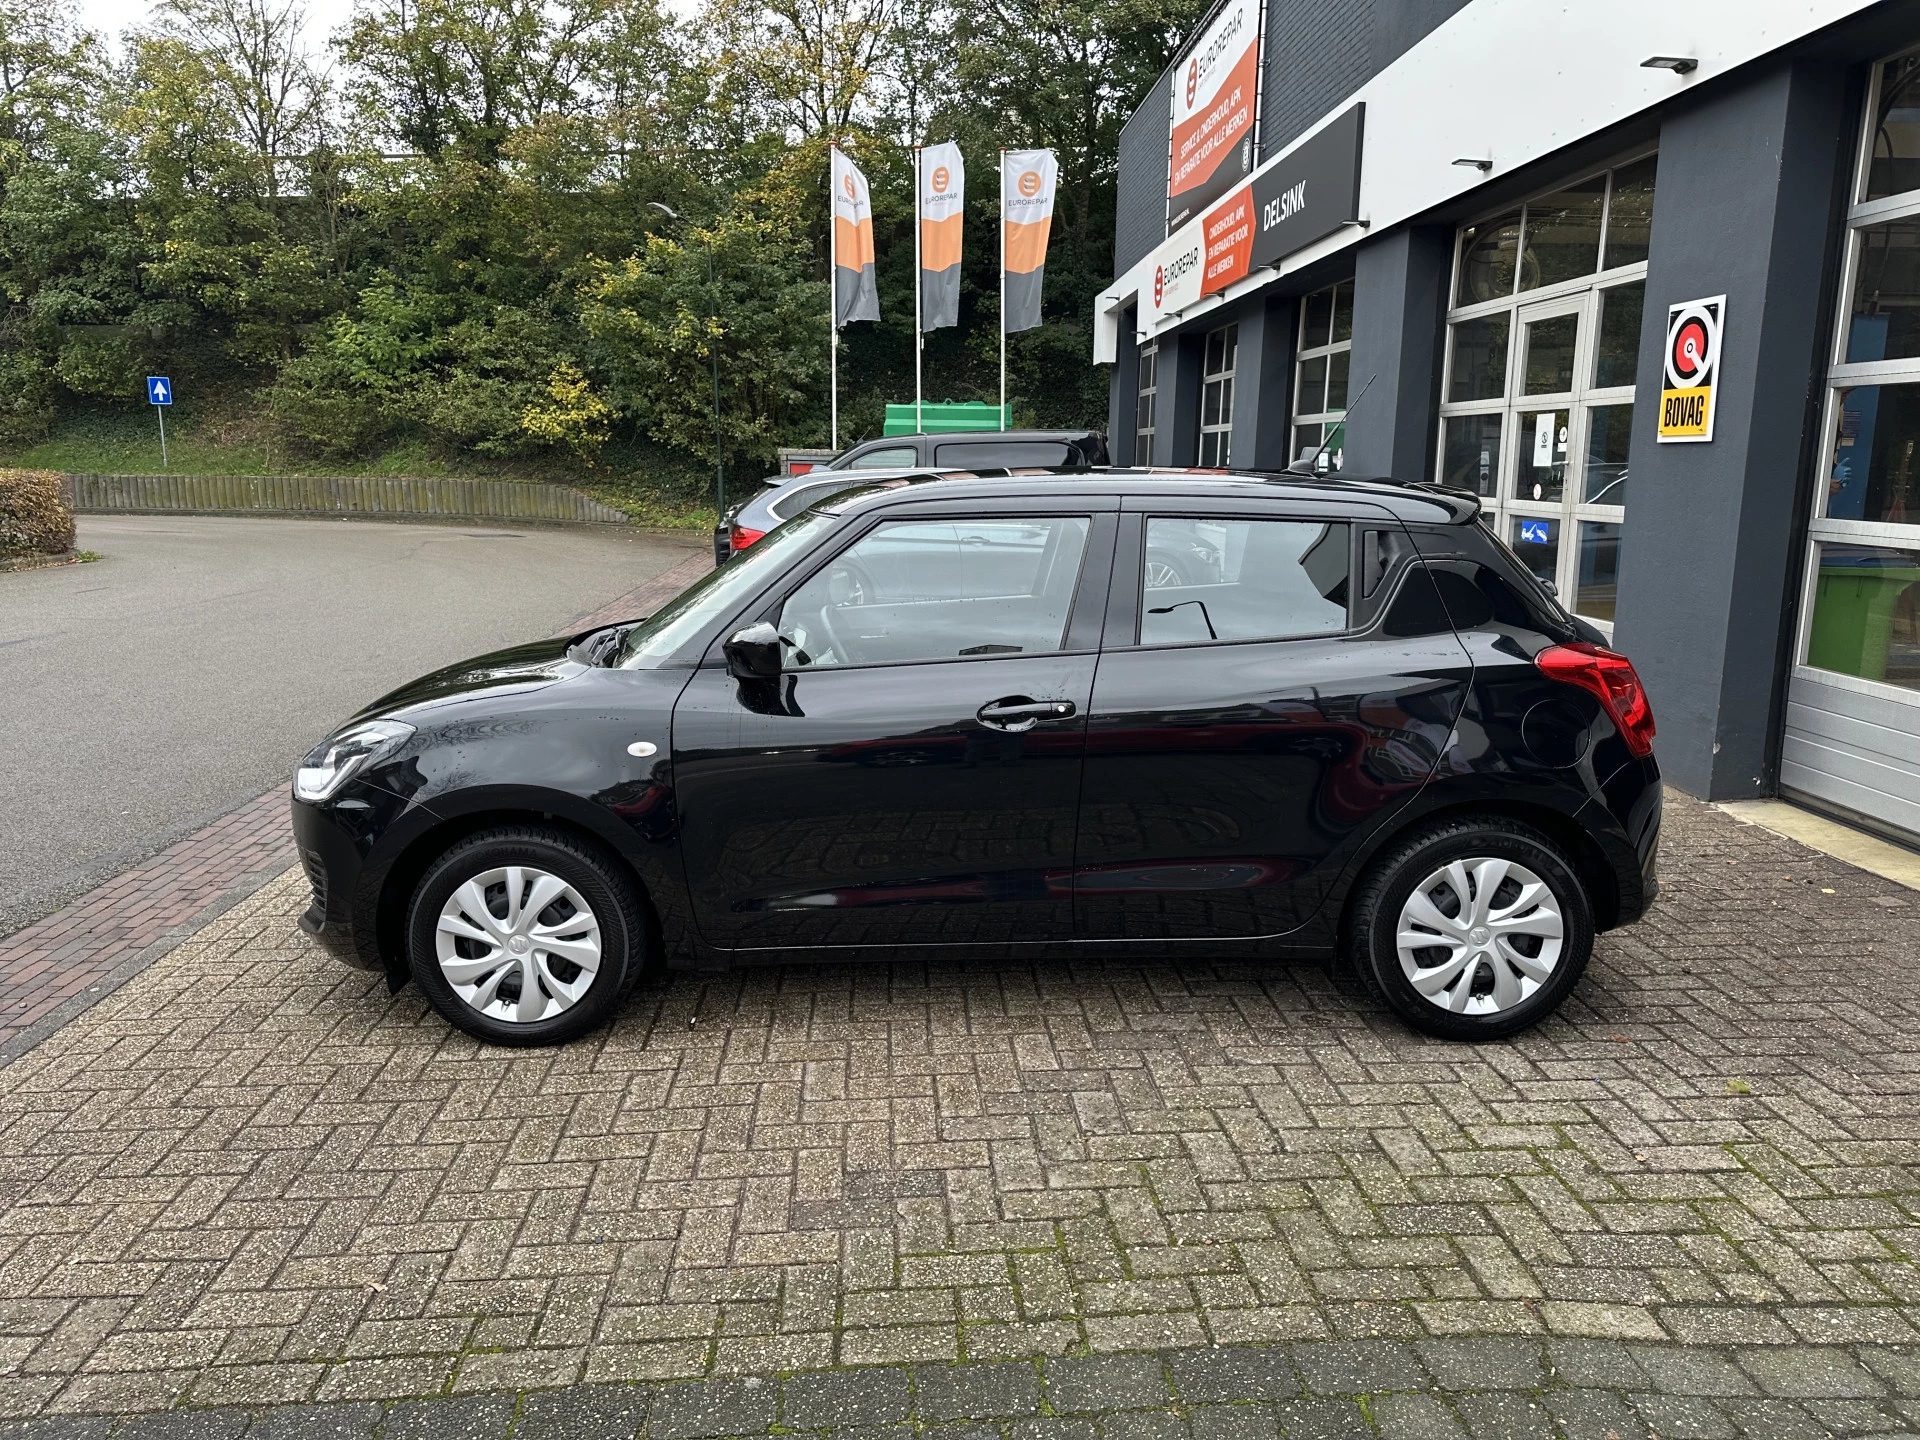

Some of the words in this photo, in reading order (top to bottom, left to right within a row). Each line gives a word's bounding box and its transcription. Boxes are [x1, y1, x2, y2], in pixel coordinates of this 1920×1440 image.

[1199, 8, 1243, 79] EUROREPAR
[1180, 131, 1197, 160] SERVICE
[1200, 98, 1230, 139] ONDERHOUD,
[1230, 84, 1242, 110] APK
[1200, 136, 1215, 161] VOOR
[1213, 125, 1226, 148] ALLE
[1225, 104, 1248, 138] WERKEN
[1235, 203, 1246, 221] APK
[1263, 179, 1306, 232] DELSINK
[1164, 246, 1199, 287] EUROREPAR
[1664, 394, 1705, 427] BOVAG
